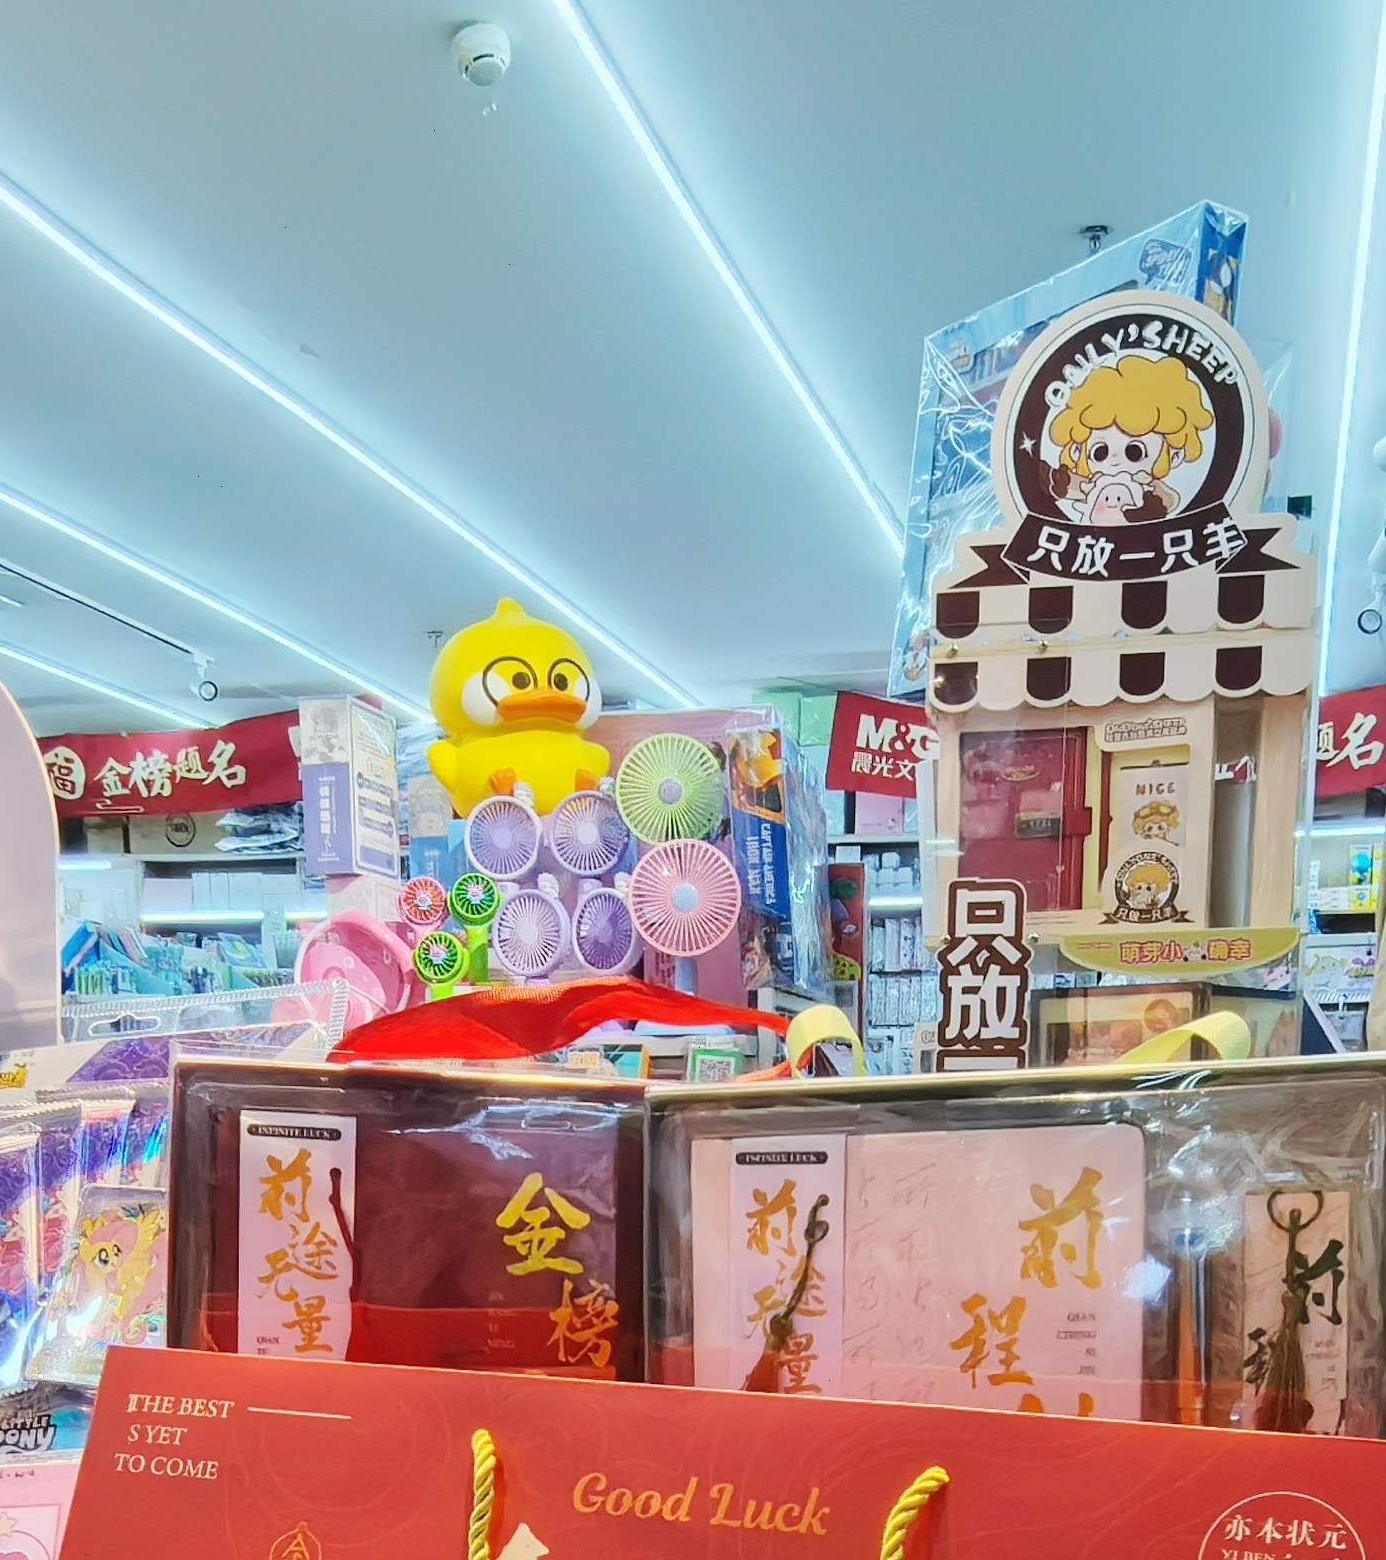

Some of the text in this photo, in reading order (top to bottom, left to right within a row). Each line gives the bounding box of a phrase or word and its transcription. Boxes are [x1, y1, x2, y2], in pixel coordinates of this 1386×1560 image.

[1027, 518, 1245, 578] 只放一只羊
[93, 740, 247, 799] 金榜题名
[257, 1148, 340, 1353] 前途无量
[496, 1172, 619, 1367] 金榜
[949, 1167, 1105, 1417] 前程
[144, 1425, 188, 1447] YET
[178, 1396, 235, 1420] BEST
[114, 1452, 219, 1482] TO COME
[572, 1471, 832, 1536] Good Luck
[1224, 1514, 1348, 1550] 亦本状元
